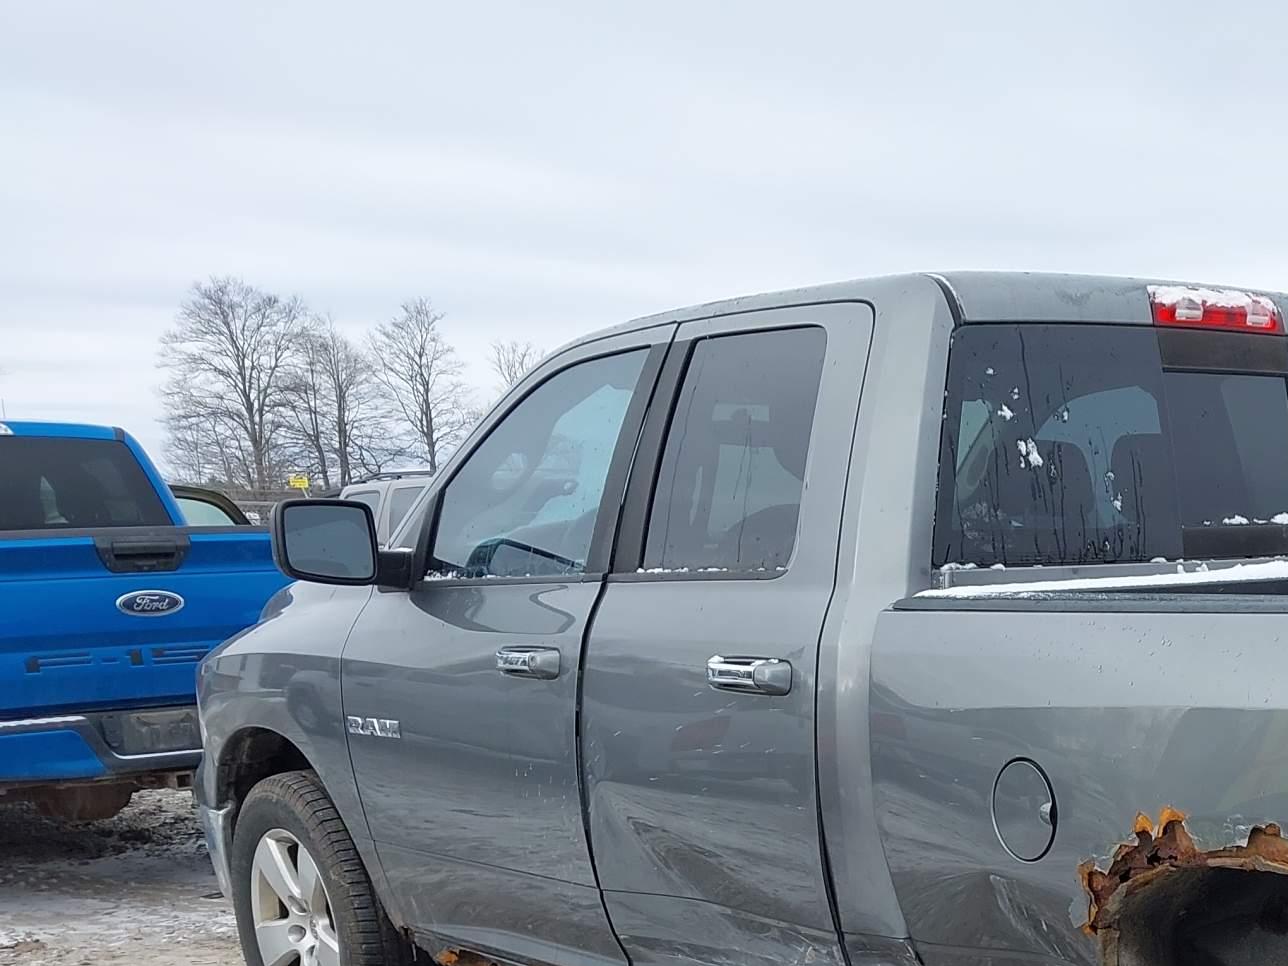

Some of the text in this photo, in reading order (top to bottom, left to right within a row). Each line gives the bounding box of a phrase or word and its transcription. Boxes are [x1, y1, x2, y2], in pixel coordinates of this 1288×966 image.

[133, 595, 170, 611] Ford
[24, 644, 211, 675] F-15
[347, 715, 401, 739] RAM
